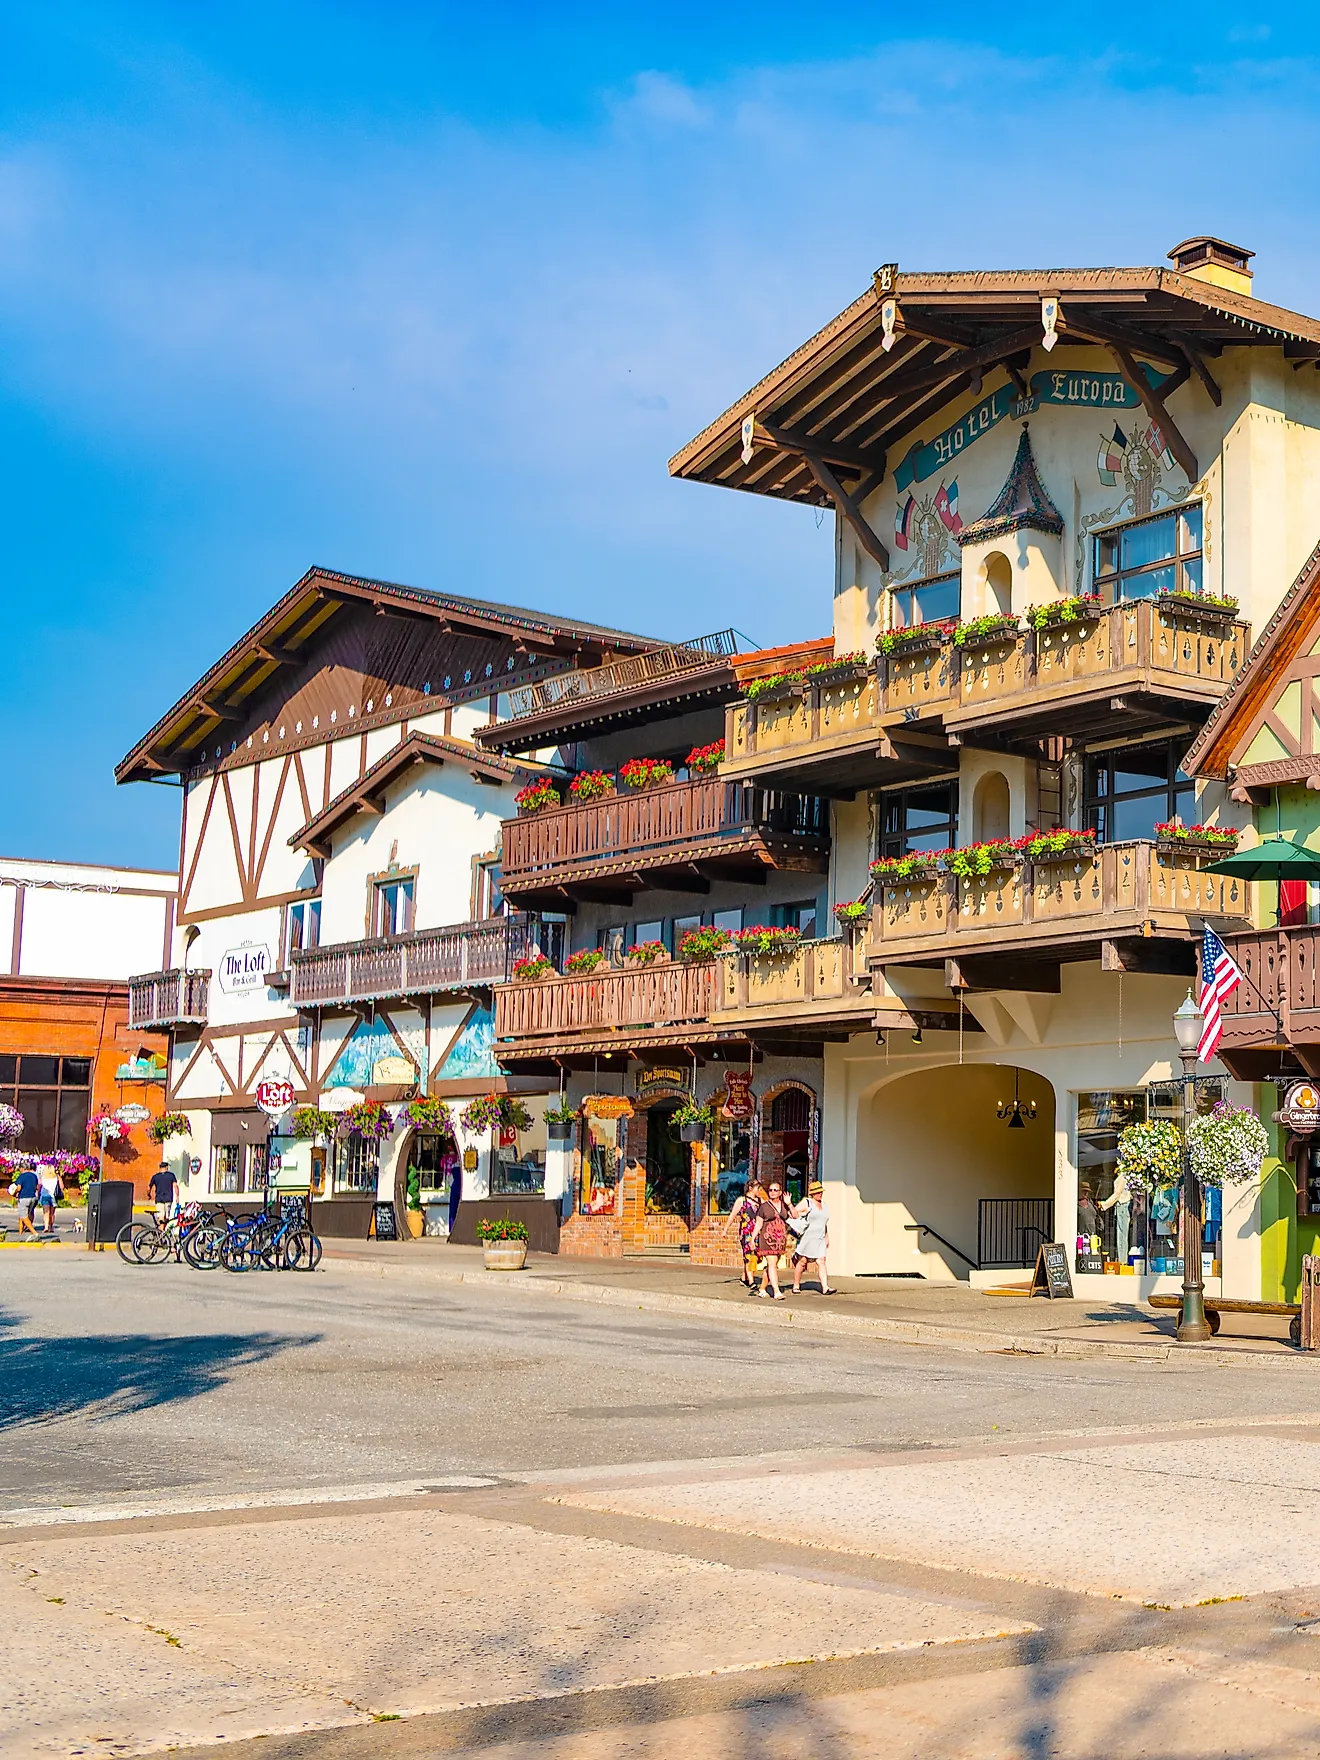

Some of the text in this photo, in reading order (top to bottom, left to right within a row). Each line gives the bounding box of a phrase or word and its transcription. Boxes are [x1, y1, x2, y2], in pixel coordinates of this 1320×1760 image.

[1016, 398, 1034, 415] 1982
[935, 373, 1125, 464] Hotel Europa
[227, 951, 265, 975] The Loft
[262, 1085, 291, 1101] Loft
